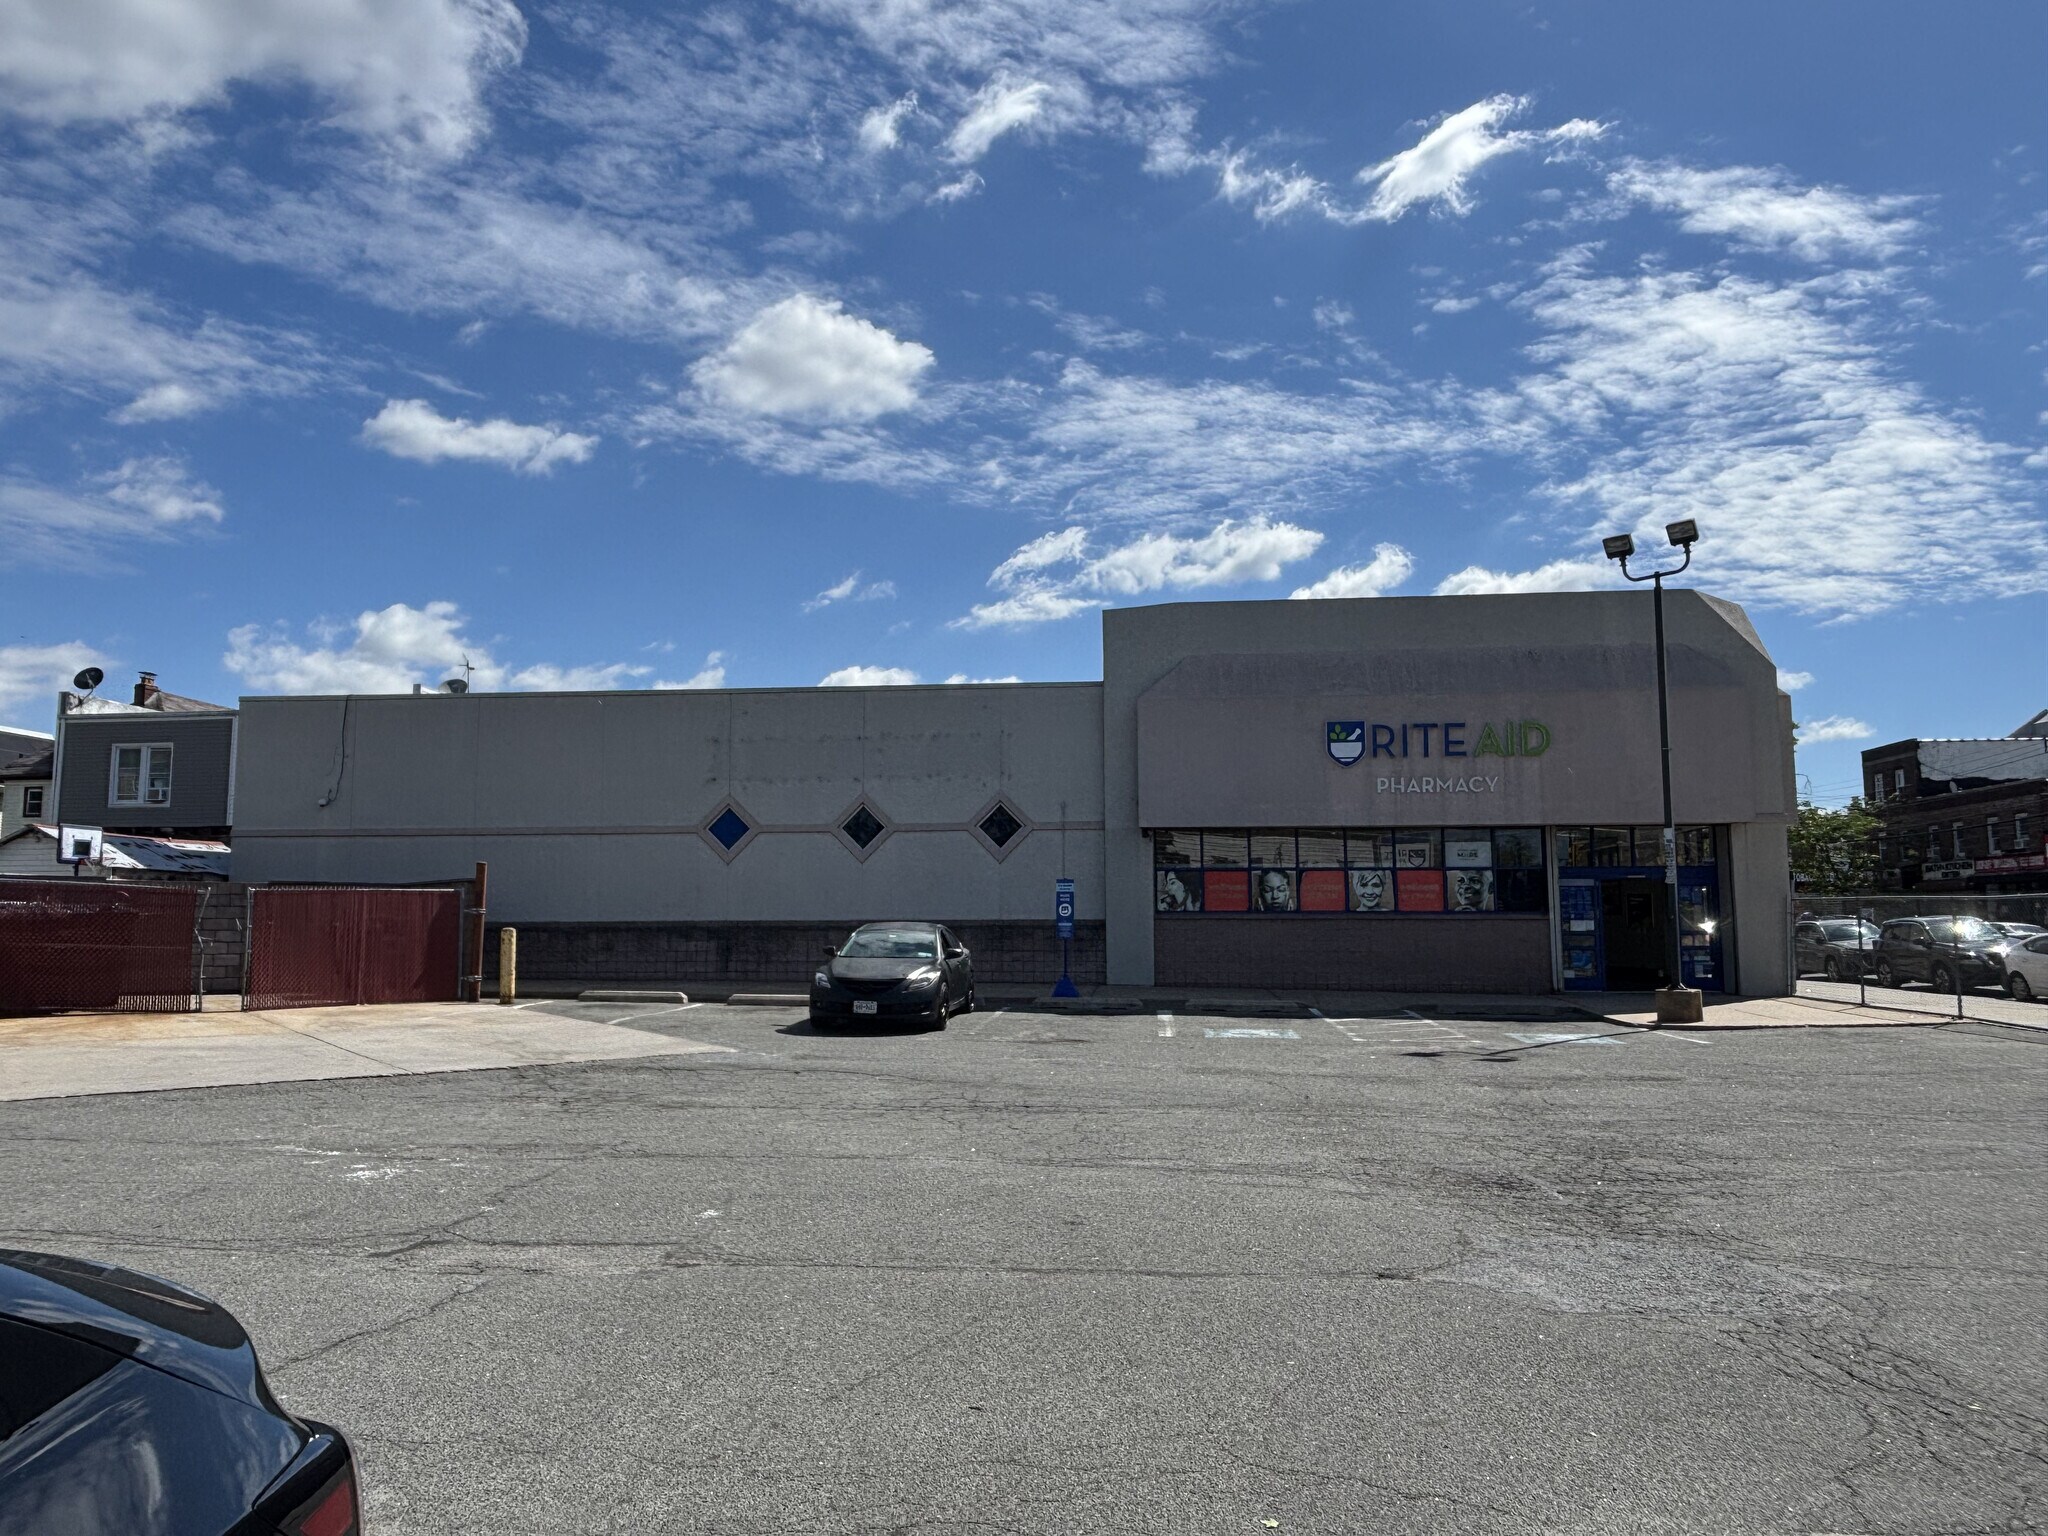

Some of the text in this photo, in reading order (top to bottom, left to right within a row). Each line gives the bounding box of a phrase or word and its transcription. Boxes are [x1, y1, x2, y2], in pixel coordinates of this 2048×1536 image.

[1371, 719, 1551, 758] RITE AID
[1376, 776, 1499, 793] PHARMACY
